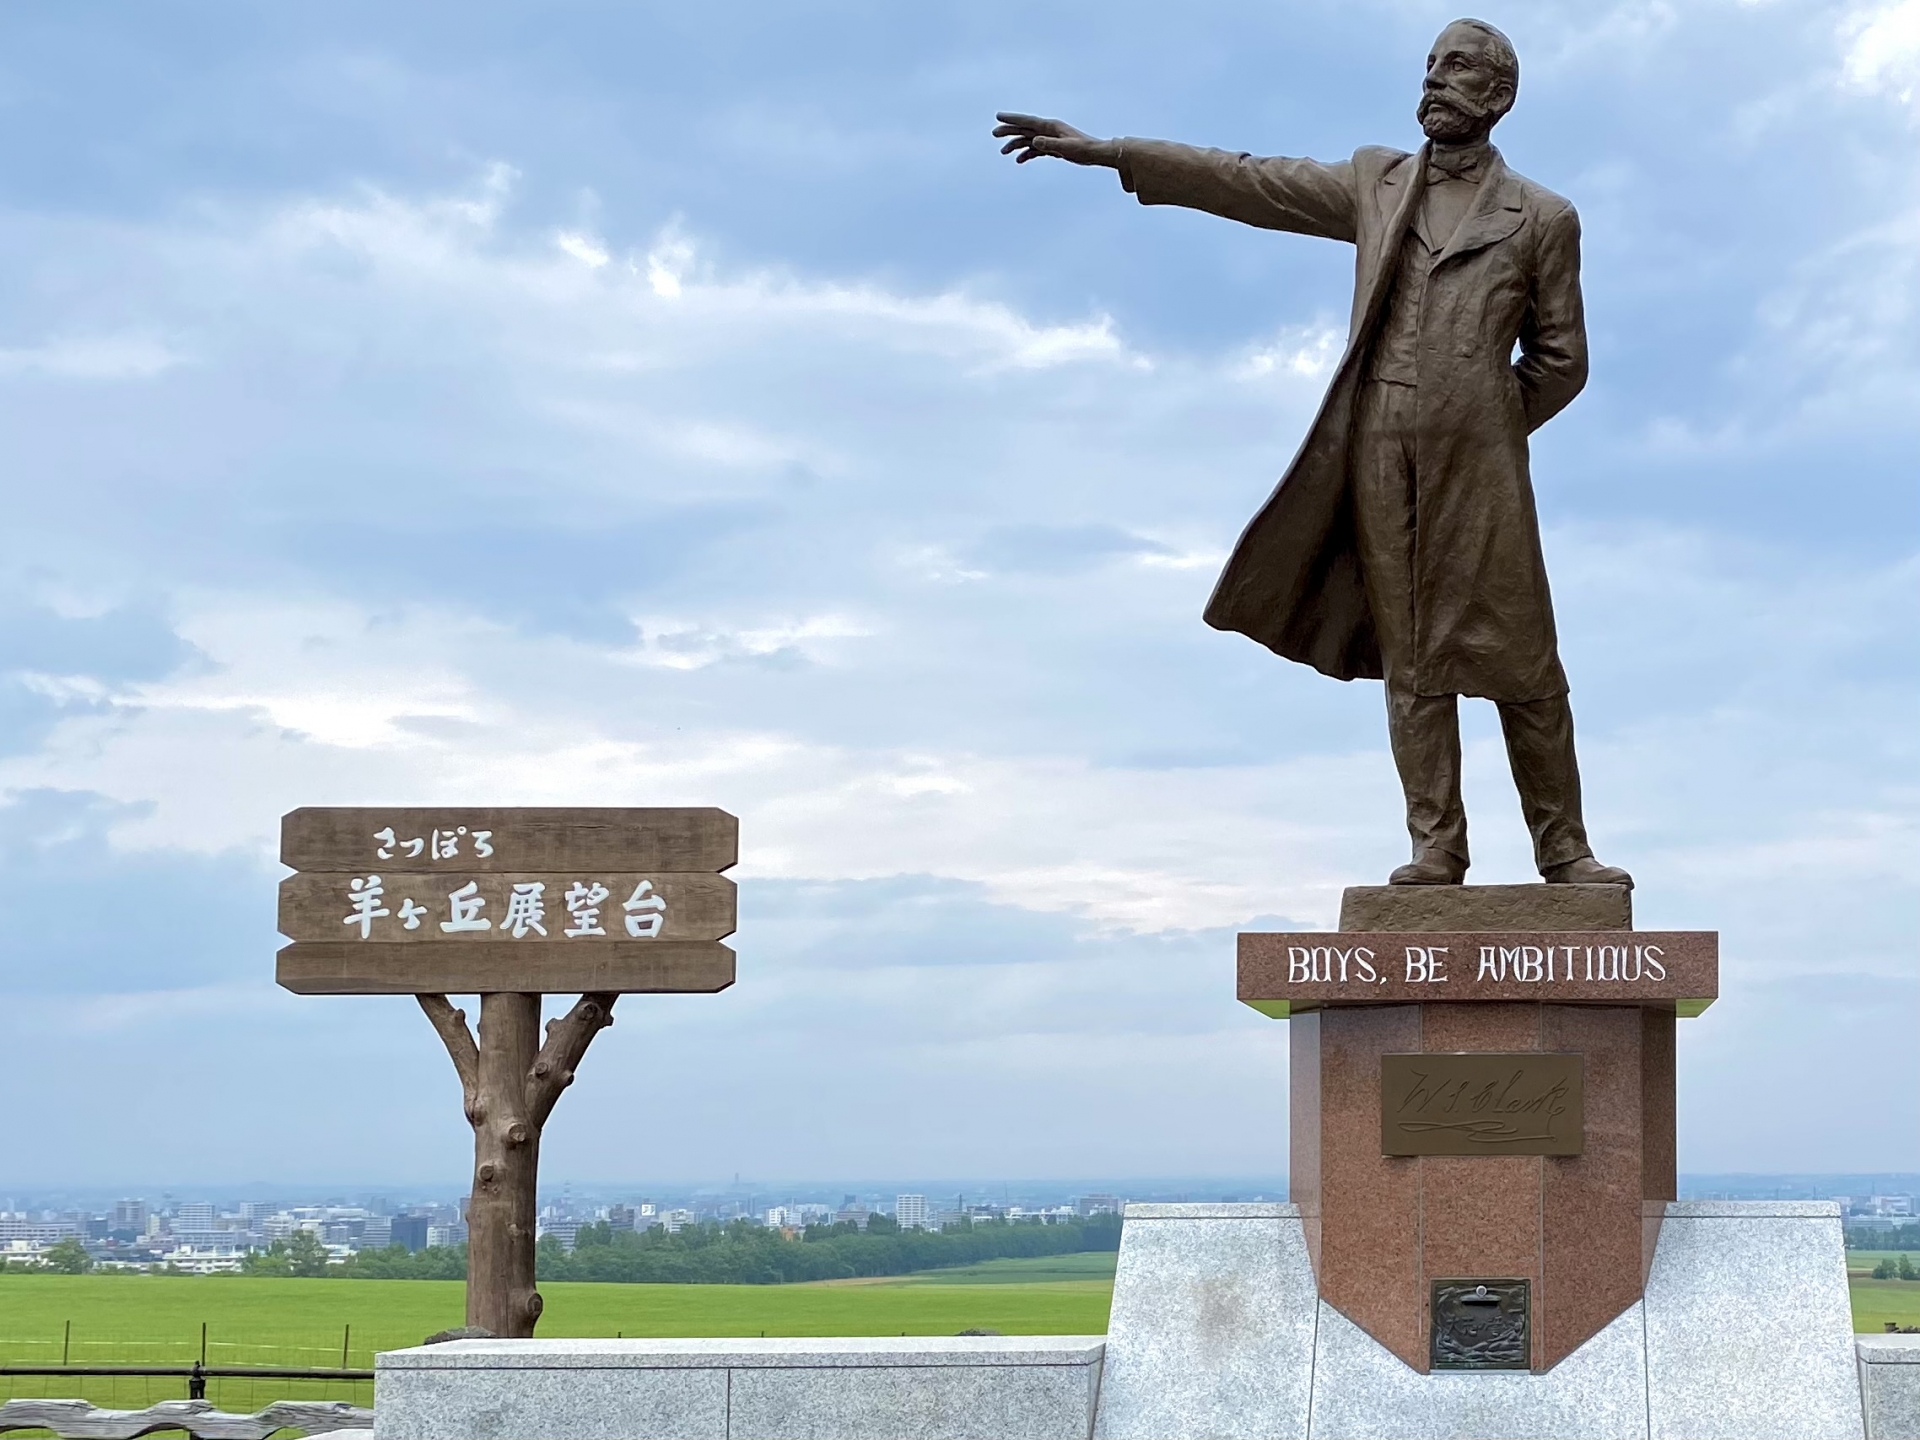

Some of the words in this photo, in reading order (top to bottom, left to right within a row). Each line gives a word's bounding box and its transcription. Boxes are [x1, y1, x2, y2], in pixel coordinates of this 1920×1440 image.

[1288, 946, 1387, 985] BOYS,
[1405, 946, 1449, 983] BE
[1477, 945, 1666, 982] AMBITIOUS
